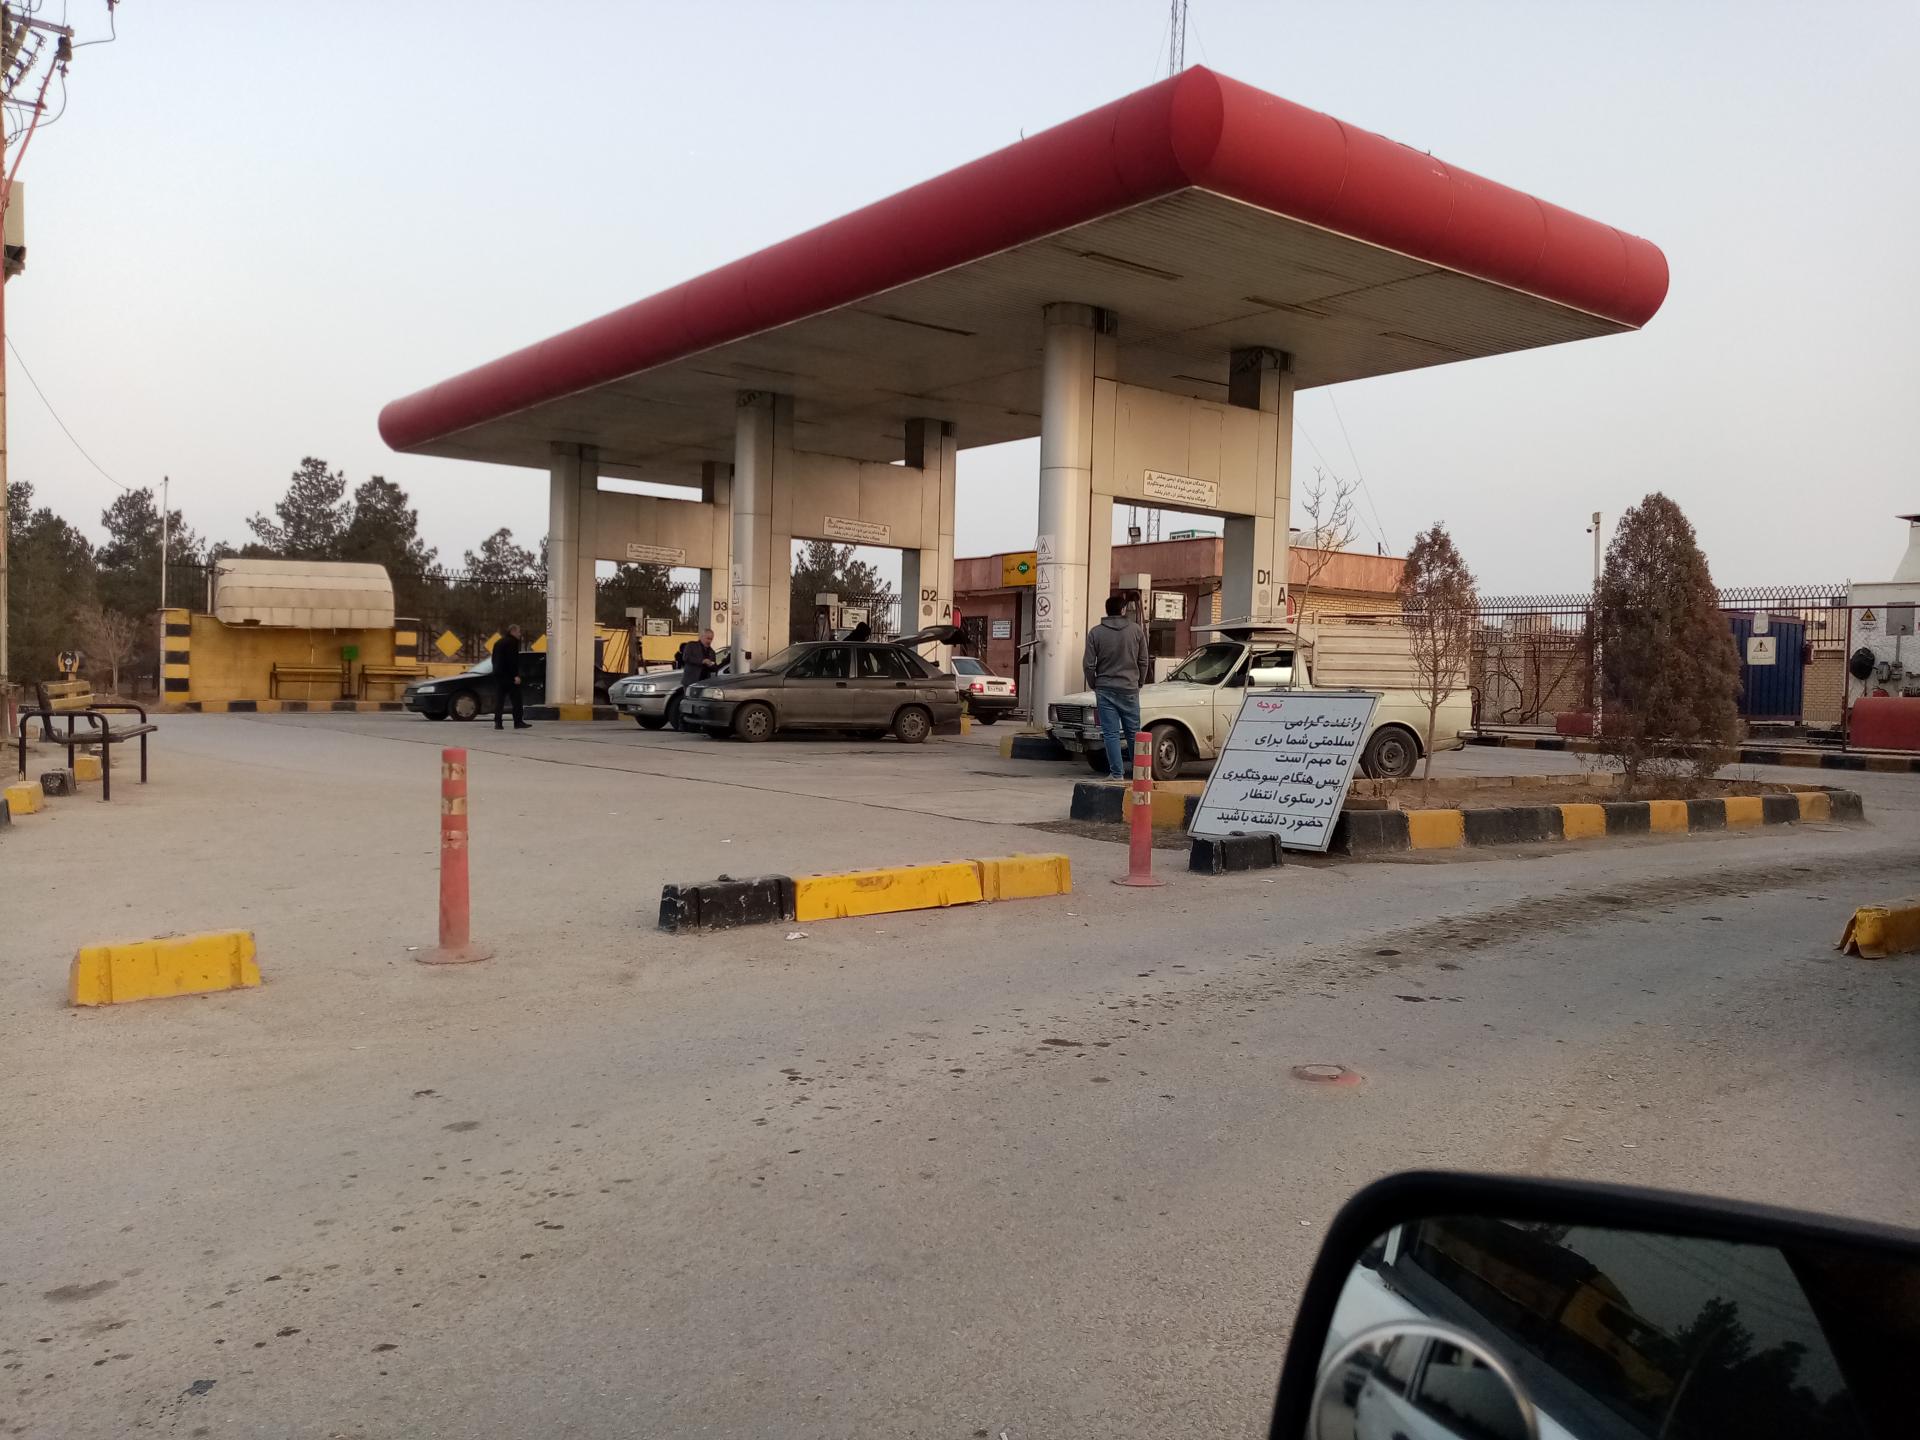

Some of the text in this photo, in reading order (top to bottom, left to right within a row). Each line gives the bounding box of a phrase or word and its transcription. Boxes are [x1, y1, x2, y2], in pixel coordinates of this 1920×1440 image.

[1257, 569, 1270, 585] D1
[922, 589, 937, 601] D2
[1278, 587, 1286, 606] A
[714, 601, 728, 611] D3
[943, 604, 951, 618] A
[1256, 700, 1284, 713] توجه
[1284, 715, 1362, 732] راننده گرامی
[1254, 734, 1354, 749] سلامتی شما برای
[1275, 753, 1347, 770] ما مهم است
[1222, 769, 1340, 792] پس هنگام سوختگیری
[1240, 788, 1332, 808] در سکوی انتظار
[1216, 808, 1324, 832] حضور داشته باشید
